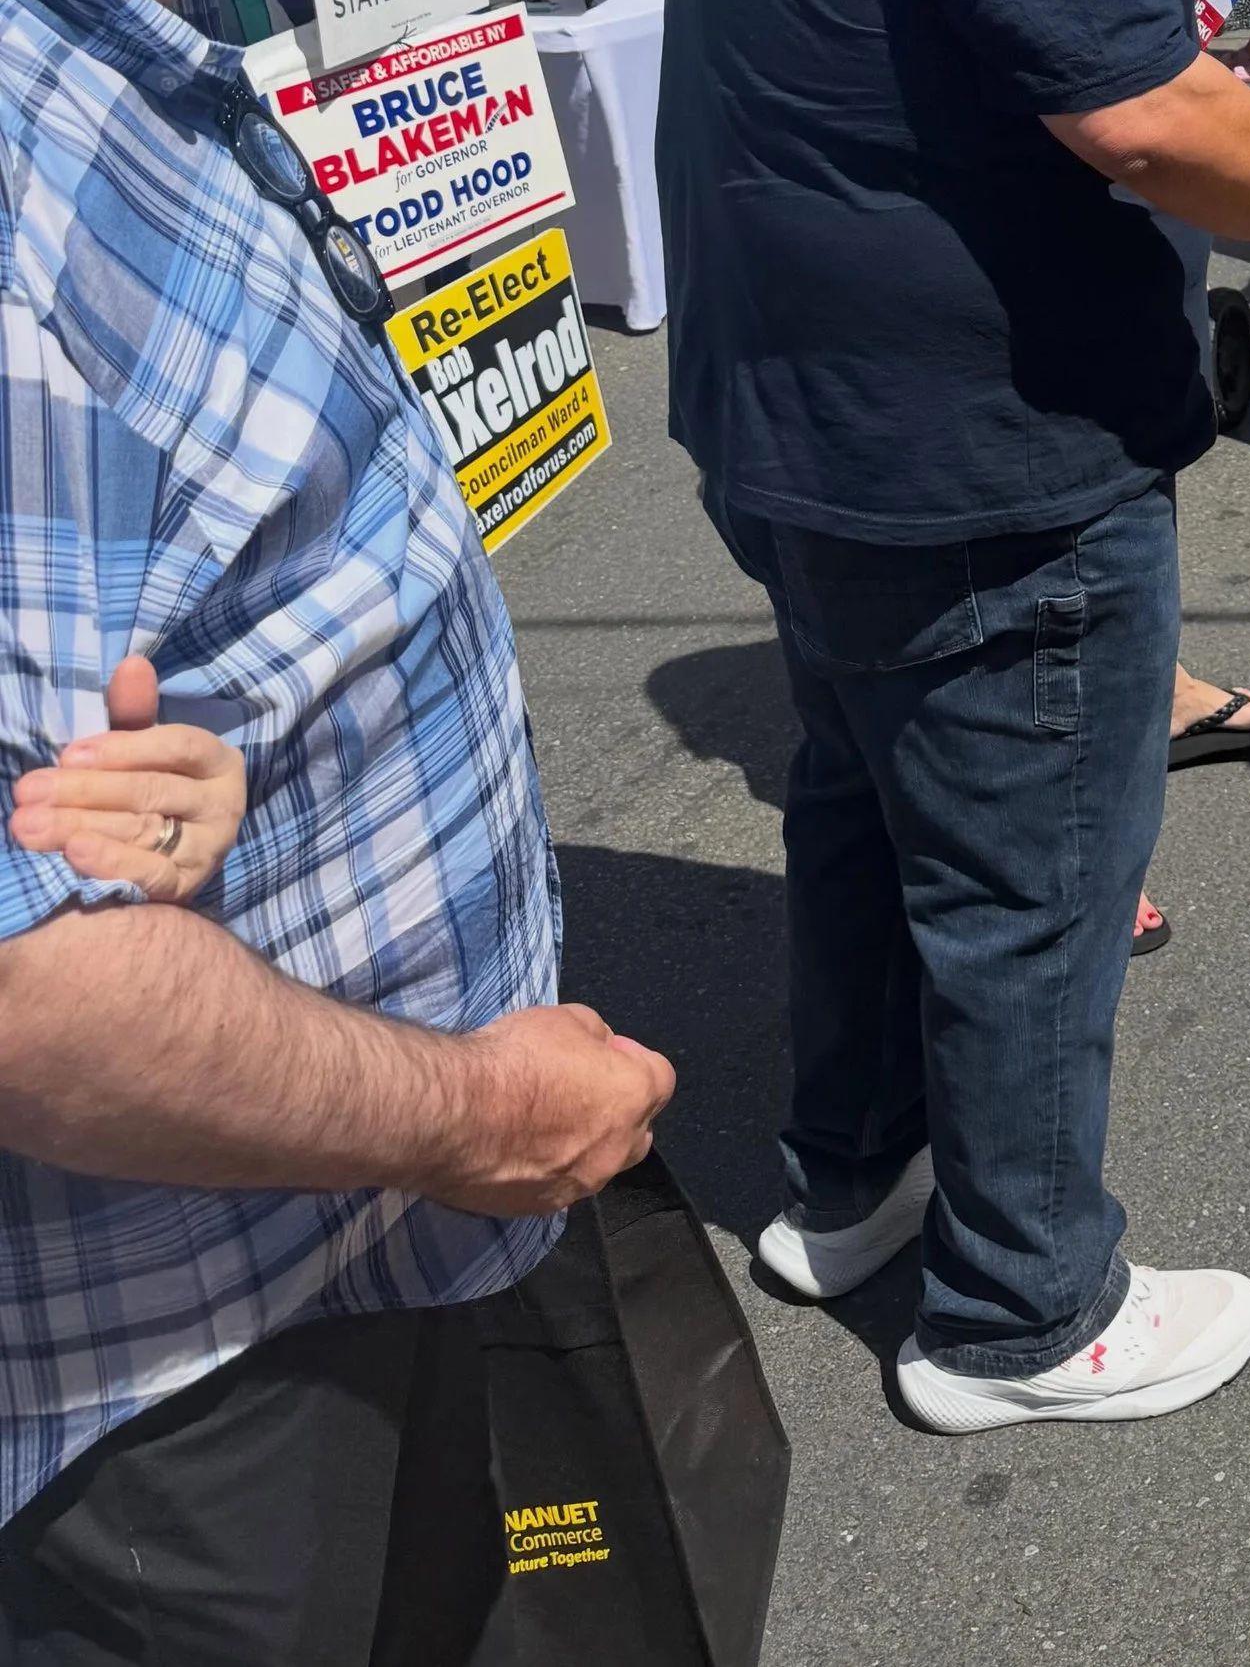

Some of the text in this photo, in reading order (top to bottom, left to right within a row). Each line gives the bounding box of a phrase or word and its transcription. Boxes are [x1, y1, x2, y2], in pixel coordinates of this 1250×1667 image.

[301, 22, 508, 104] A SAFER & AFFORDABLE NY
[352, 61, 488, 138] BRUCE
[312, 84, 534, 195] BLAKEMAN
[394, 139, 489, 193] for GOVERNOR
[352, 188, 445, 248] TODD
[450, 151, 532, 208] HOOD
[373, 241, 392, 261] for
[393, 209, 467, 252] LIEUTENANT
[469, 182, 531, 217] GOVERNOR
[410, 246, 552, 354] Re-Elect
[426, 344, 475, 394] Bob
[547, 391, 581, 432] Ward
[581, 385, 590, 405] 4
[504, 1500, 599, 1533] NANUET
[509, 1527, 604, 1553] Commerce
[508, 1547, 611, 1574] uture Together
